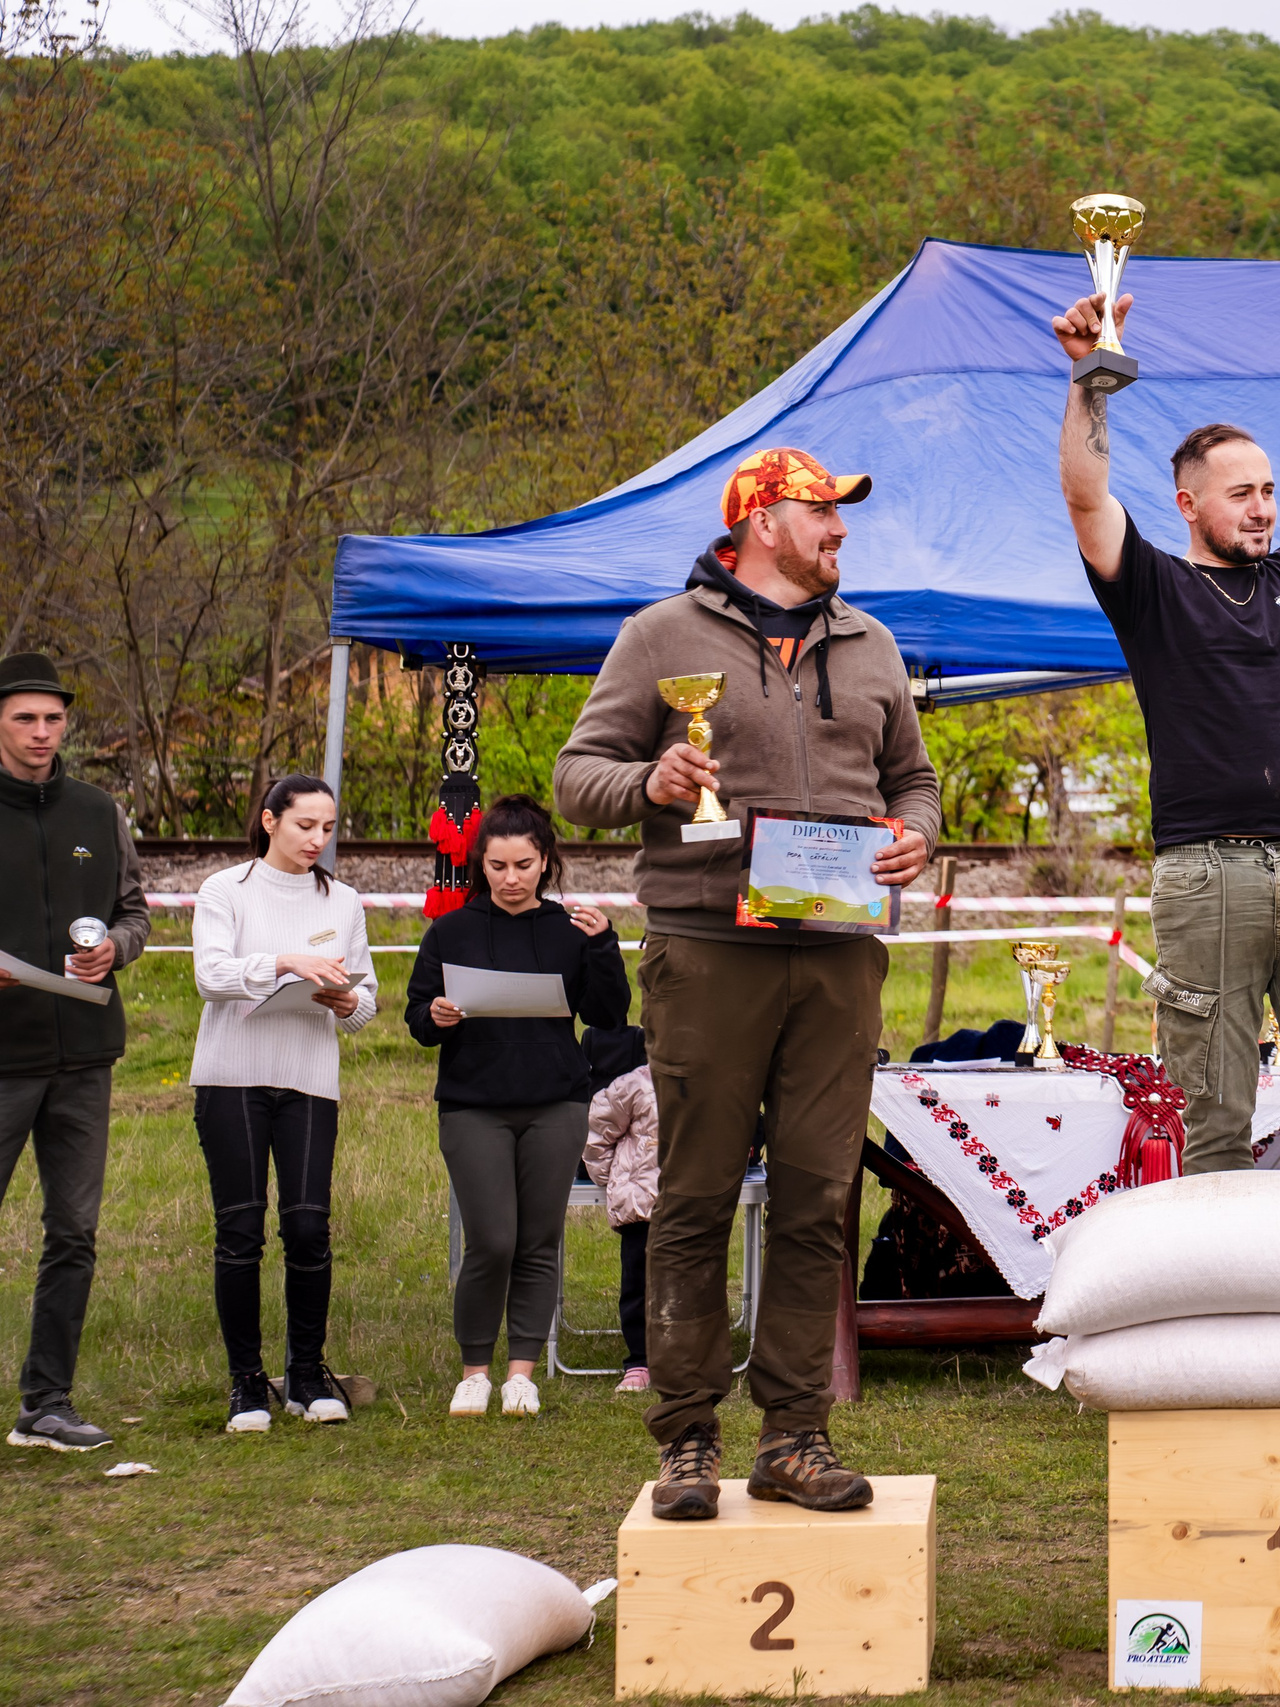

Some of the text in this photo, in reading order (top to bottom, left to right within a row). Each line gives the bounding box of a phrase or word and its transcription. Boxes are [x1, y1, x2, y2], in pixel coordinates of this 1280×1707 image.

[750, 1581, 795, 1651] 2
[1126, 1654, 1189, 1664] PRO ATLETIC
